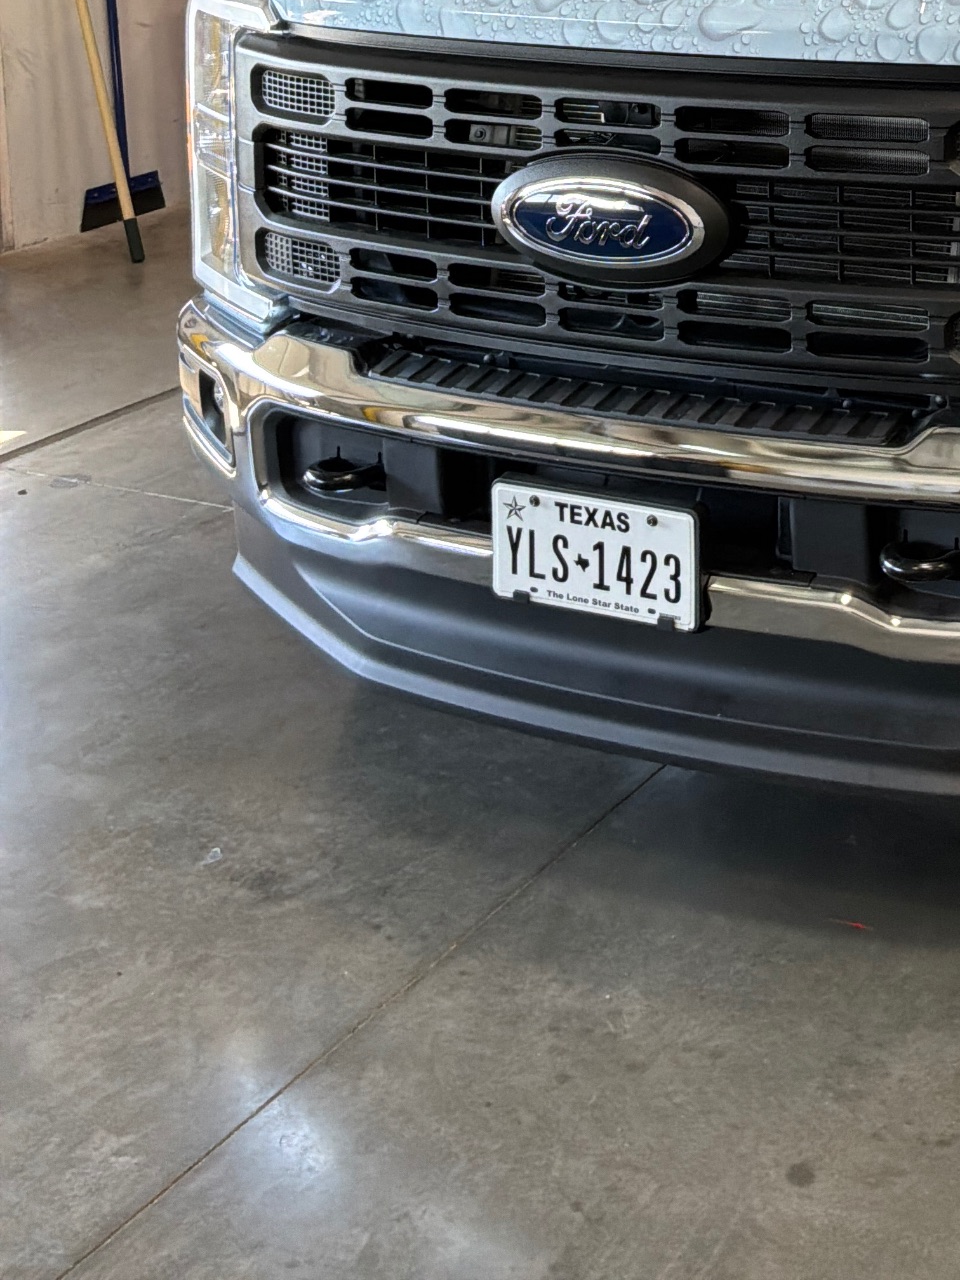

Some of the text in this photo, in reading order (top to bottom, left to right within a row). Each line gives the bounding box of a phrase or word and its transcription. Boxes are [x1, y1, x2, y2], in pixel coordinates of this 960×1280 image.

[545, 192, 653, 250] Ford
[554, 501, 630, 533] TEXAS
[546, 589, 640, 614] The Lone Star State
